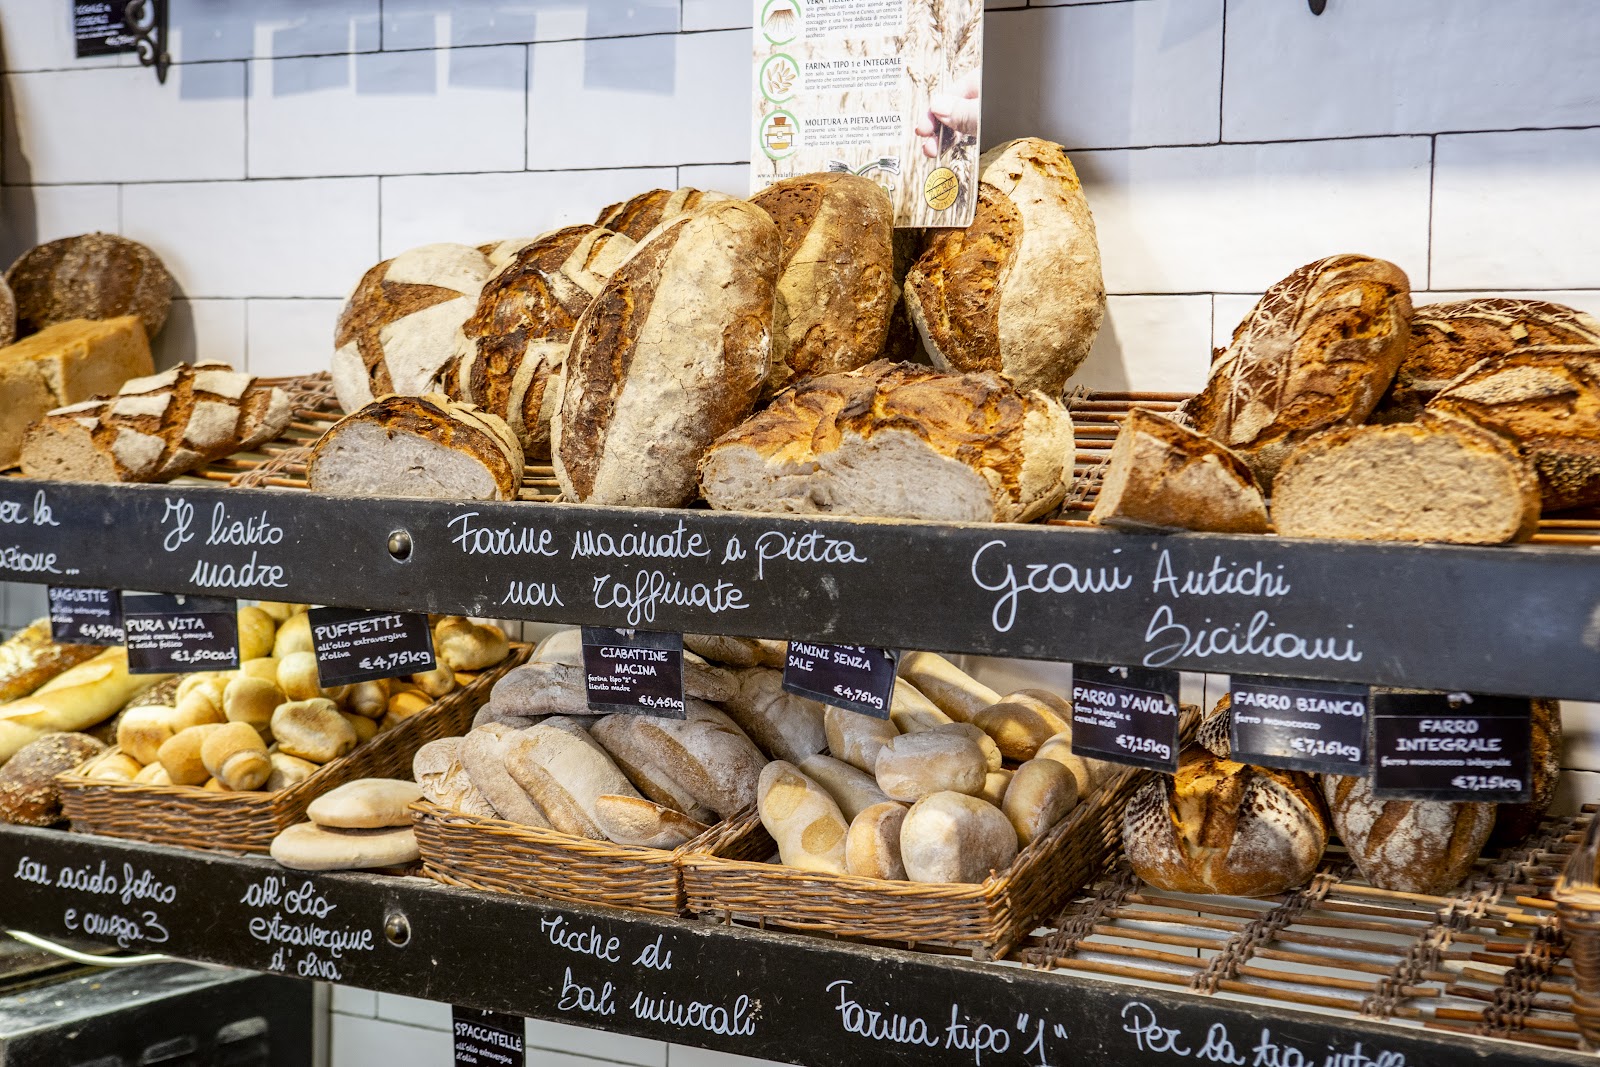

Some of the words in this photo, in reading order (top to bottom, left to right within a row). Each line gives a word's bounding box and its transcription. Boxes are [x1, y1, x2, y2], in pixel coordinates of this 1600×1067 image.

[805, 62, 831, 70] FARINA
[863, 57, 901, 67] INTEGRALE
[805, 118, 842, 126] MOLITURA
[850, 116, 874, 124] PIETRA
[876, 115, 901, 124] LAVICA
[0, 500, 28, 524] er
[161, 498, 195, 552] Il
[206, 502, 283, 546] lievito
[447, 511, 558, 556] Farine
[571, 519, 711, 560] macinate
[721, 534, 747, 565] a
[755, 528, 868, 580] pietra
[189, 551, 288, 588] madre
[49, 588, 109, 602] BAGUETTE
[502, 580, 565, 607] non
[972, 540, 1132, 633] Grani
[1153, 549, 1291, 599] Antichi
[125, 619, 165, 632] PURA
[168, 617, 205, 631] VITA
[314, 614, 404, 641] PUFFETTI
[1143, 605, 1363, 668] Siciliani
[317, 642, 351, 652] all'olio
[353, 632, 408, 646] extravergine
[600, 647, 668, 662] CIABATTINE
[319, 651, 351, 661] d'oliva
[359, 650, 431, 670] €4,75kg
[788, 655, 814, 671] SALE
[790, 641, 830, 660] PANINI
[833, 651, 871, 671] SENZA
[615, 663, 657, 676] MACINA
[833, 684, 884, 709] €4,75kg
[1073, 687, 1116, 707] FARRO
[1120, 693, 1177, 716] D'AVOLA
[1233, 691, 1291, 711] FARRO
[1296, 697, 1366, 717] BIANCO
[1419, 720, 1479, 734] FARRO
[1115, 734, 1171, 760] €7,15kg
[1396, 738, 1502, 752] INTEGRALE
[14, 856, 51, 885] con
[56, 860, 117, 894] acido
[119, 862, 176, 905] folico
[64, 908, 79, 929] e
[249, 912, 374, 958] extravergine
[632, 934, 672, 970] di
[630, 991, 756, 1036] minerali
[826, 980, 939, 1045] Farina
[945, 1003, 1010, 1066] tipo
[1121, 1002, 1191, 1056] Per
[1196, 1023, 1246, 1065] la
